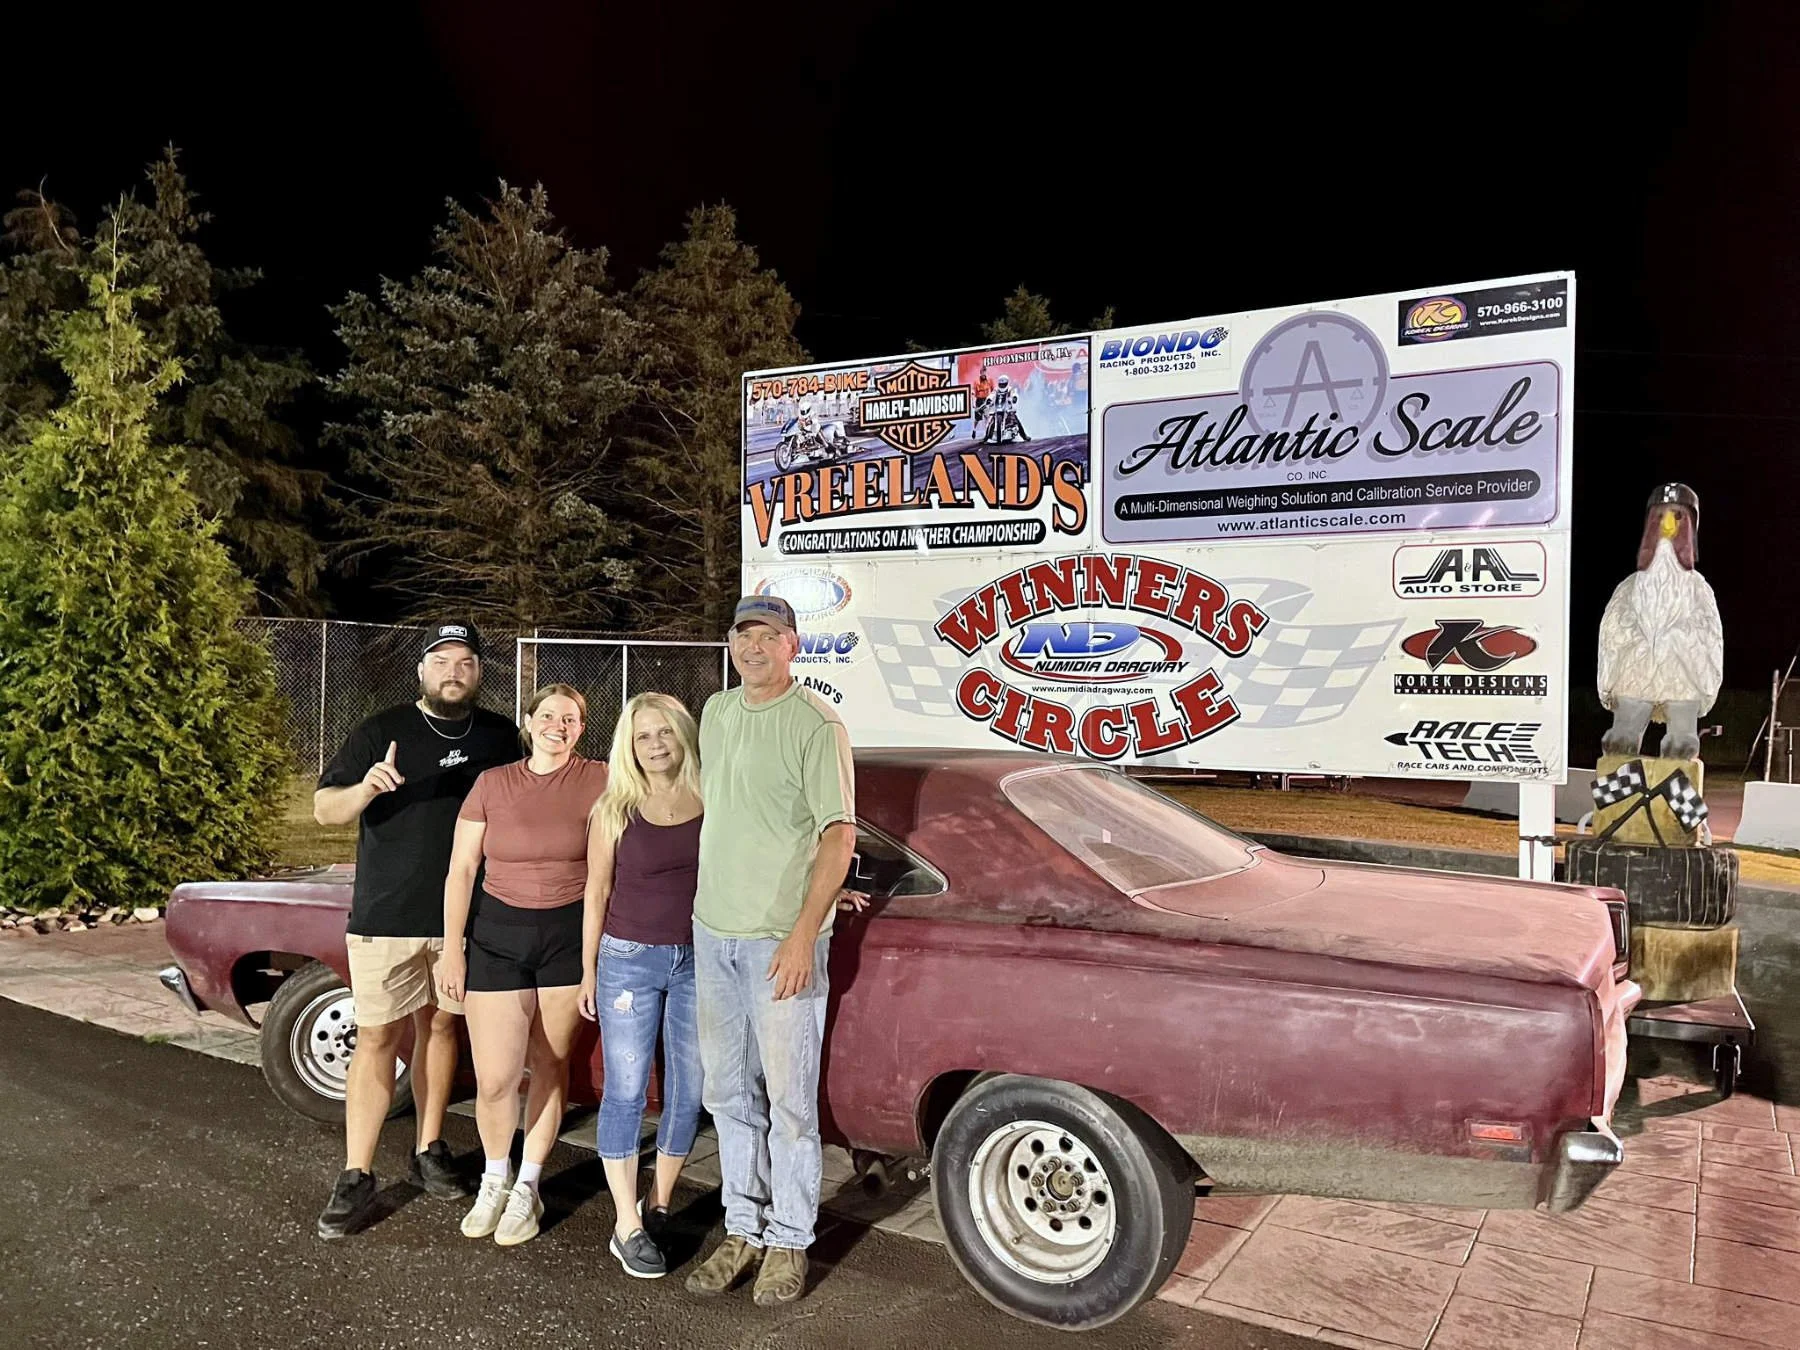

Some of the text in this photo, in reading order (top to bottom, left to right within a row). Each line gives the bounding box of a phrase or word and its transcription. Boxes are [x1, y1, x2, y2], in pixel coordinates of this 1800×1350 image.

[1477, 297, 1563, 318] 570-966-3100
[1404, 322, 1469, 337] KOREK DESIGNS
[1100, 326, 1230, 360] BIONDO
[1100, 350, 1222, 369] RACING PRODUCTS, INC.
[1124, 361, 1197, 377] 1-800-332-1320
[752, 370, 868, 400] 570-784-BIKE
[886, 372, 940, 394] MOTOR
[865, 392, 965, 421] HARLEY-DAVIDSON
[889, 421, 943, 447] CYCLES
[1118, 376, 1542, 475] Atlantic Scale
[1287, 470, 1327, 481] CO. INC
[747, 452, 1089, 548] VREELAND'S
[1120, 477, 1533, 514] A Multi-Dimensional Weighing Solution and Calibration Service Provider
[1217, 512, 1406, 532] www.atlanticscale.com
[783, 523, 1041, 552] CONGRATULATIONS ON ANOTHER CHAMPIONSHIP
[1403, 583, 1523, 594] AUTO STORE
[934, 553, 1270, 659] WINNERS
[798, 631, 860, 655] NDO
[792, 656, 854, 664] ODUCTS, INC.
[1033, 660, 1190, 674] NUMIDIA DRAGWAY
[795, 676, 843, 704] AND'S
[1031, 684, 1154, 695] www.numidiadragway.com
[1394, 675, 1548, 688] KOREK DESIGNS
[956, 666, 1242, 760] CIRCLE
[1409, 720, 1518, 741] RACE
[1409, 741, 1517, 763] TECH
[1397, 762, 1550, 775] RACE CARS AND COMPONENTS
